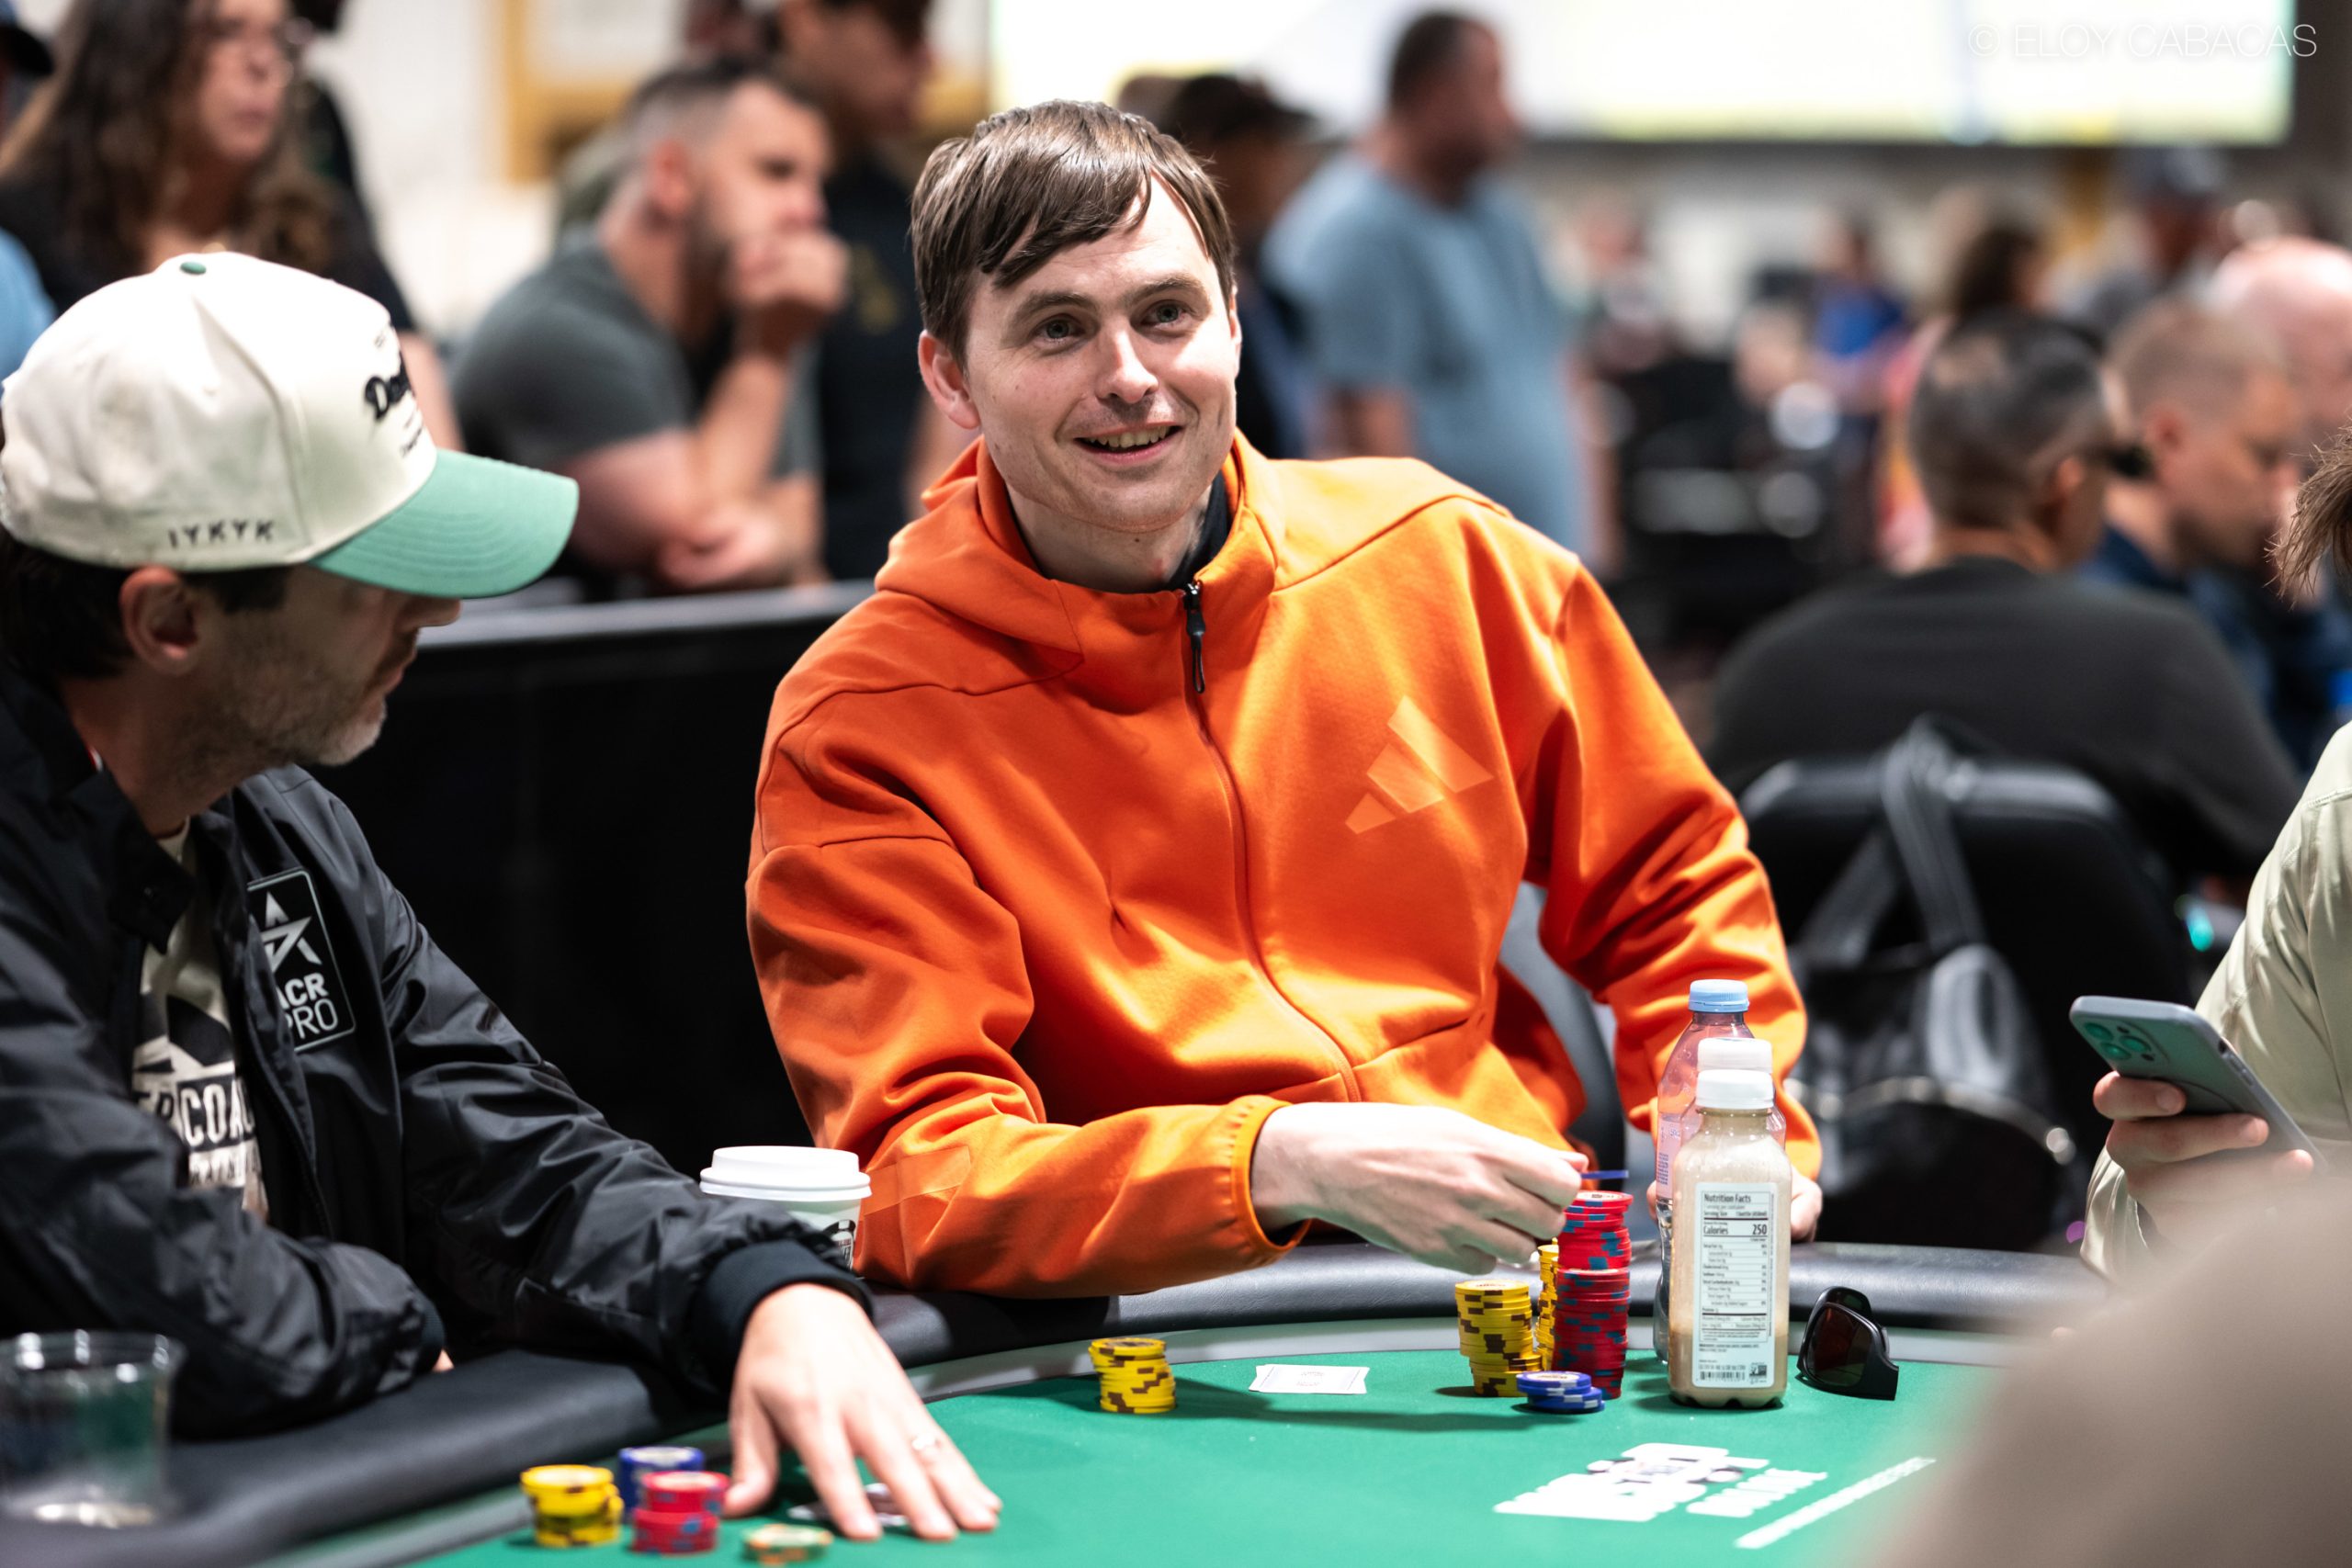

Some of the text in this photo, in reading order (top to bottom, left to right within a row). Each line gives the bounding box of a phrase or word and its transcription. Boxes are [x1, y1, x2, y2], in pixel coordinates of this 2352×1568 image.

[168, 519, 275, 549] IYKYK
[1703, 1193, 1751, 1203] Nutrition Facts
[1703, 1224, 1768, 1235] Calories 250
